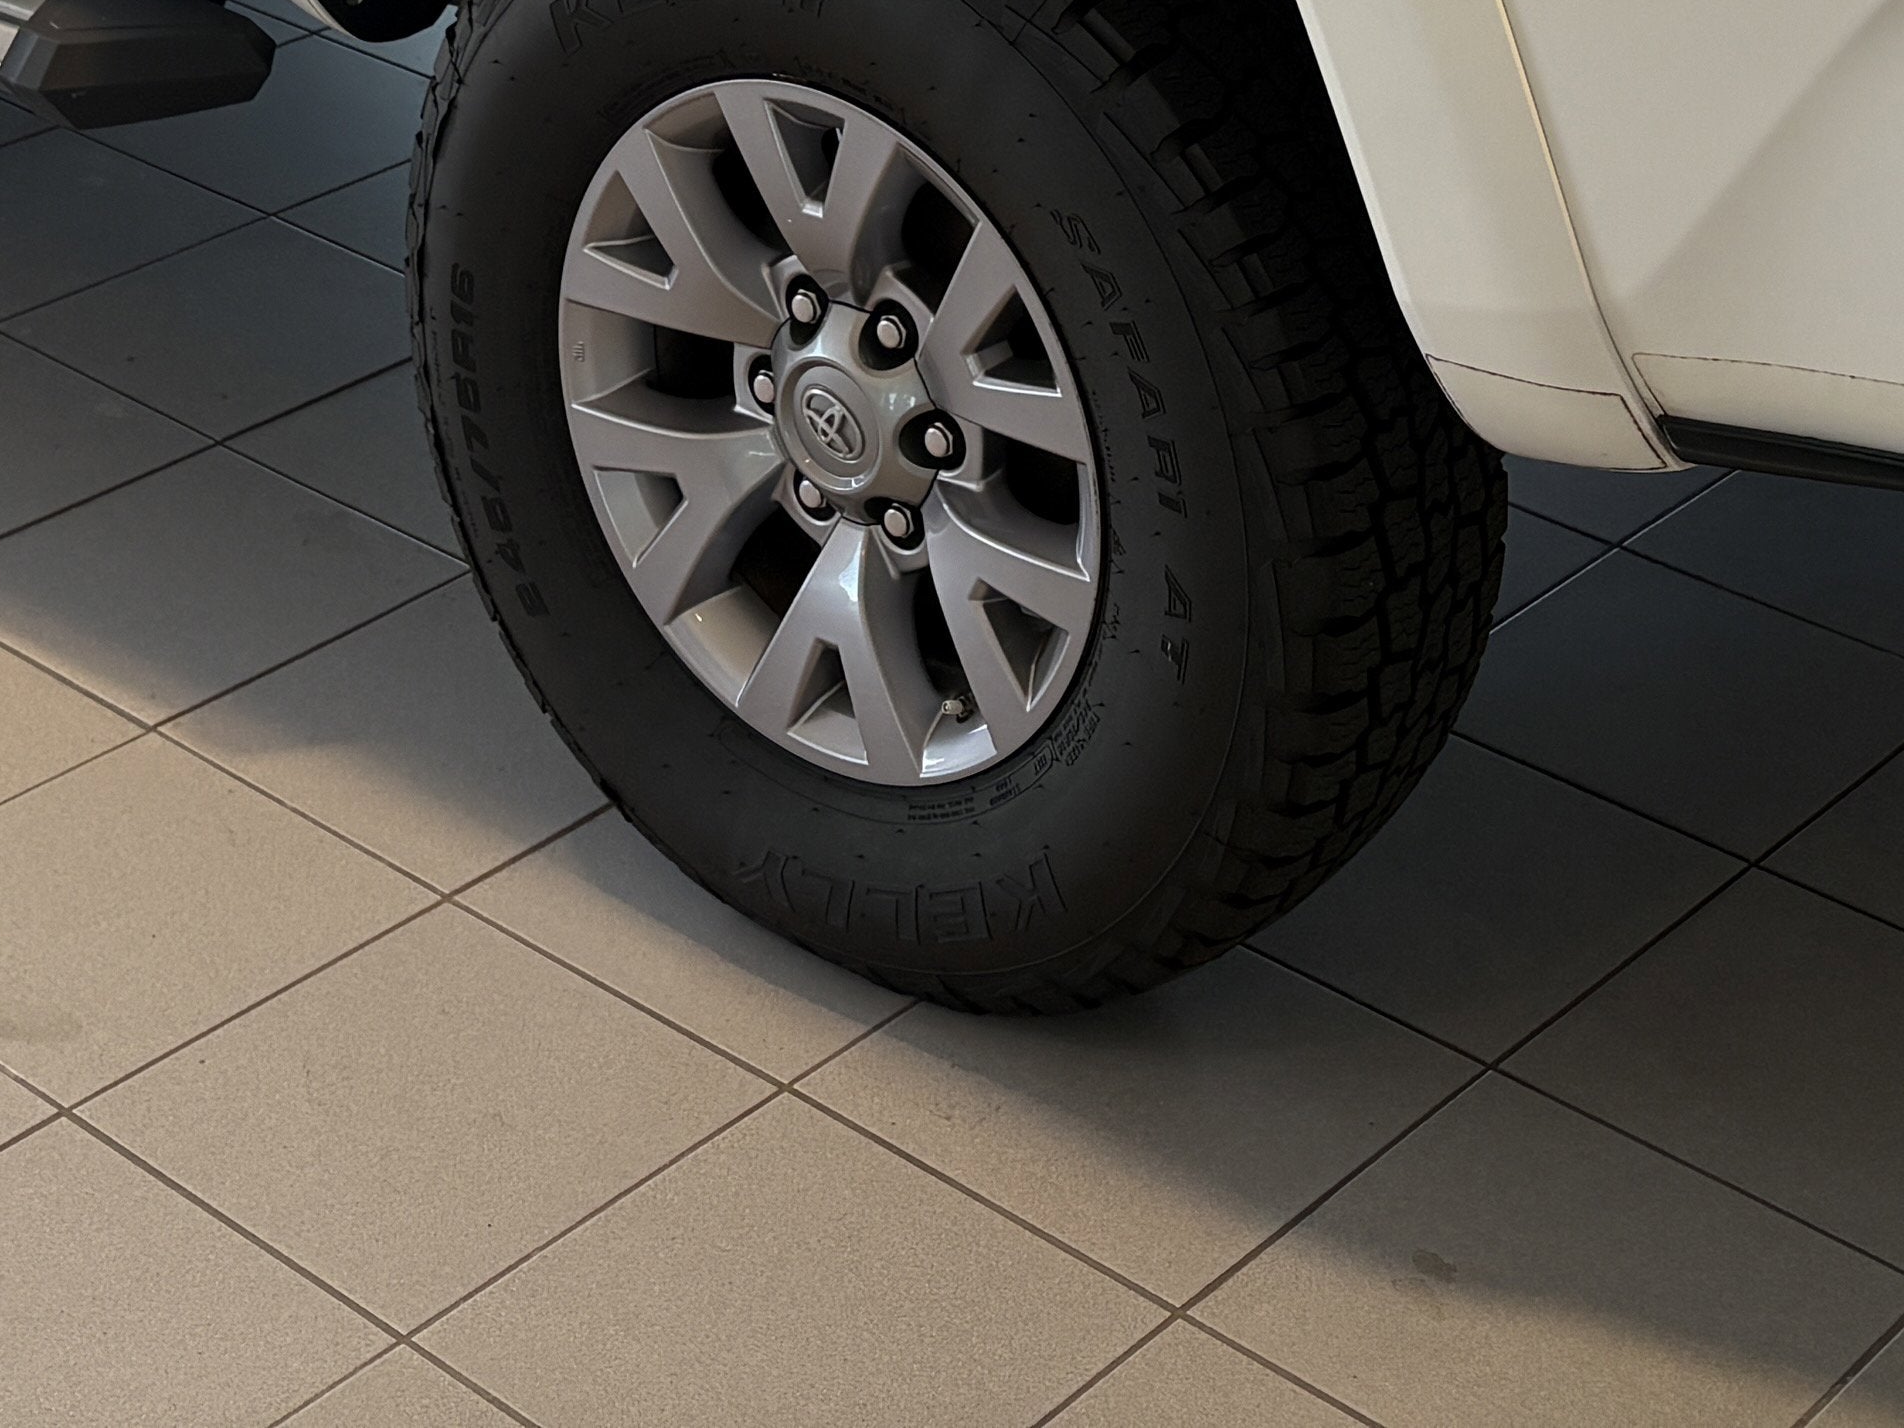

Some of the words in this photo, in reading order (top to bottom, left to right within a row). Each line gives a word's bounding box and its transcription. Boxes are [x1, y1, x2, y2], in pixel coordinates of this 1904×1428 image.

[448, 261, 552, 619] 245/75R16
[1049, 207, 1190, 520] SAFARI
[1160, 563, 1194, 687] AT
[731, 850, 1069, 947] KELLY
